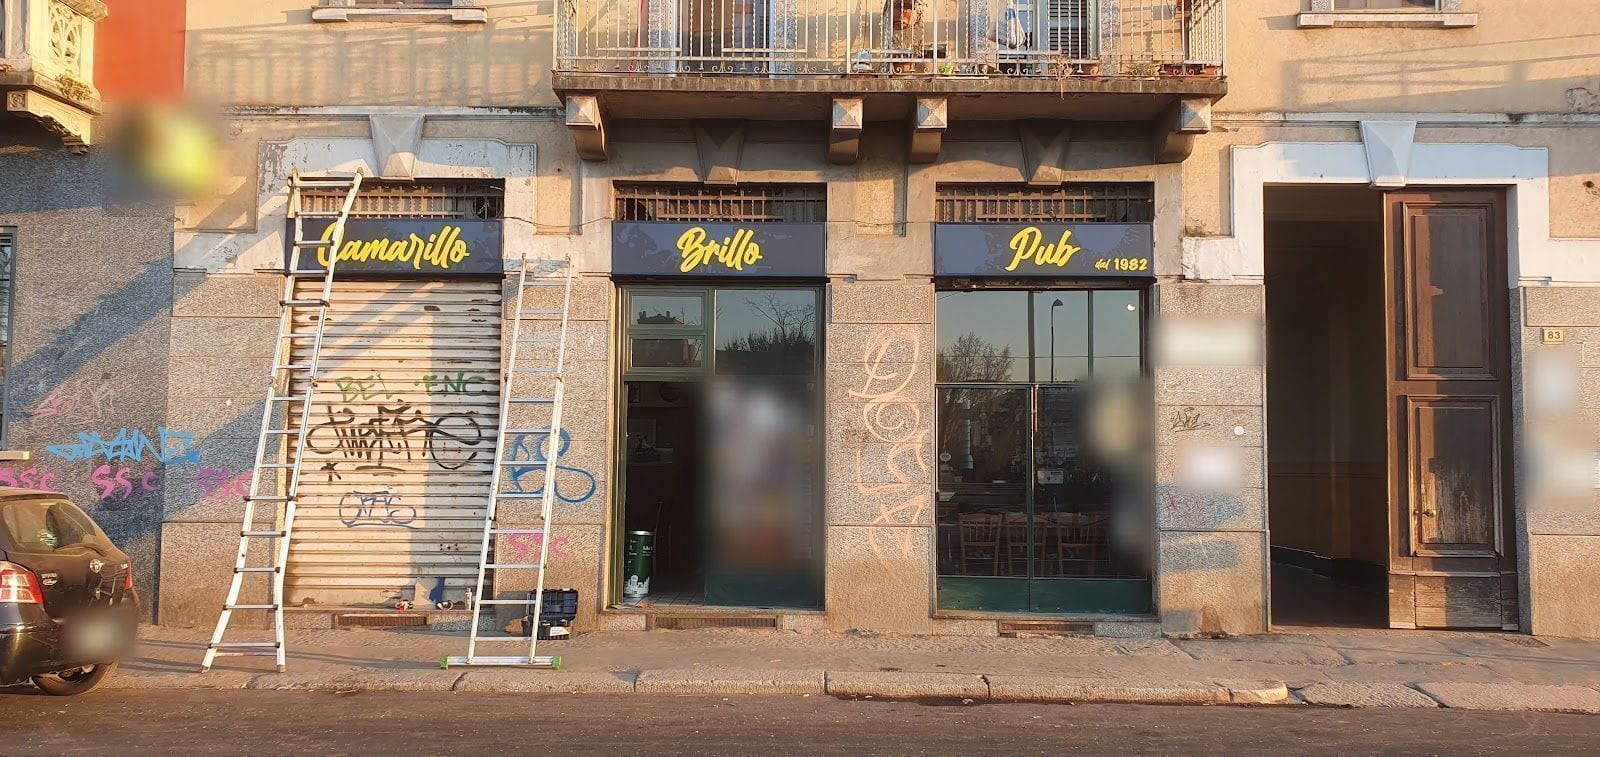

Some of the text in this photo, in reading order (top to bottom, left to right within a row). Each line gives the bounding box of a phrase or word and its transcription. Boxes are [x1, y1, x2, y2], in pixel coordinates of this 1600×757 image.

[317, 221, 470, 270] Camarillo
[676, 227, 763, 273] Brillo
[1005, 226, 1081, 272] Pub
[1094, 257, 1149, 271] dal 1982
[1547, 330, 1561, 340] 83
